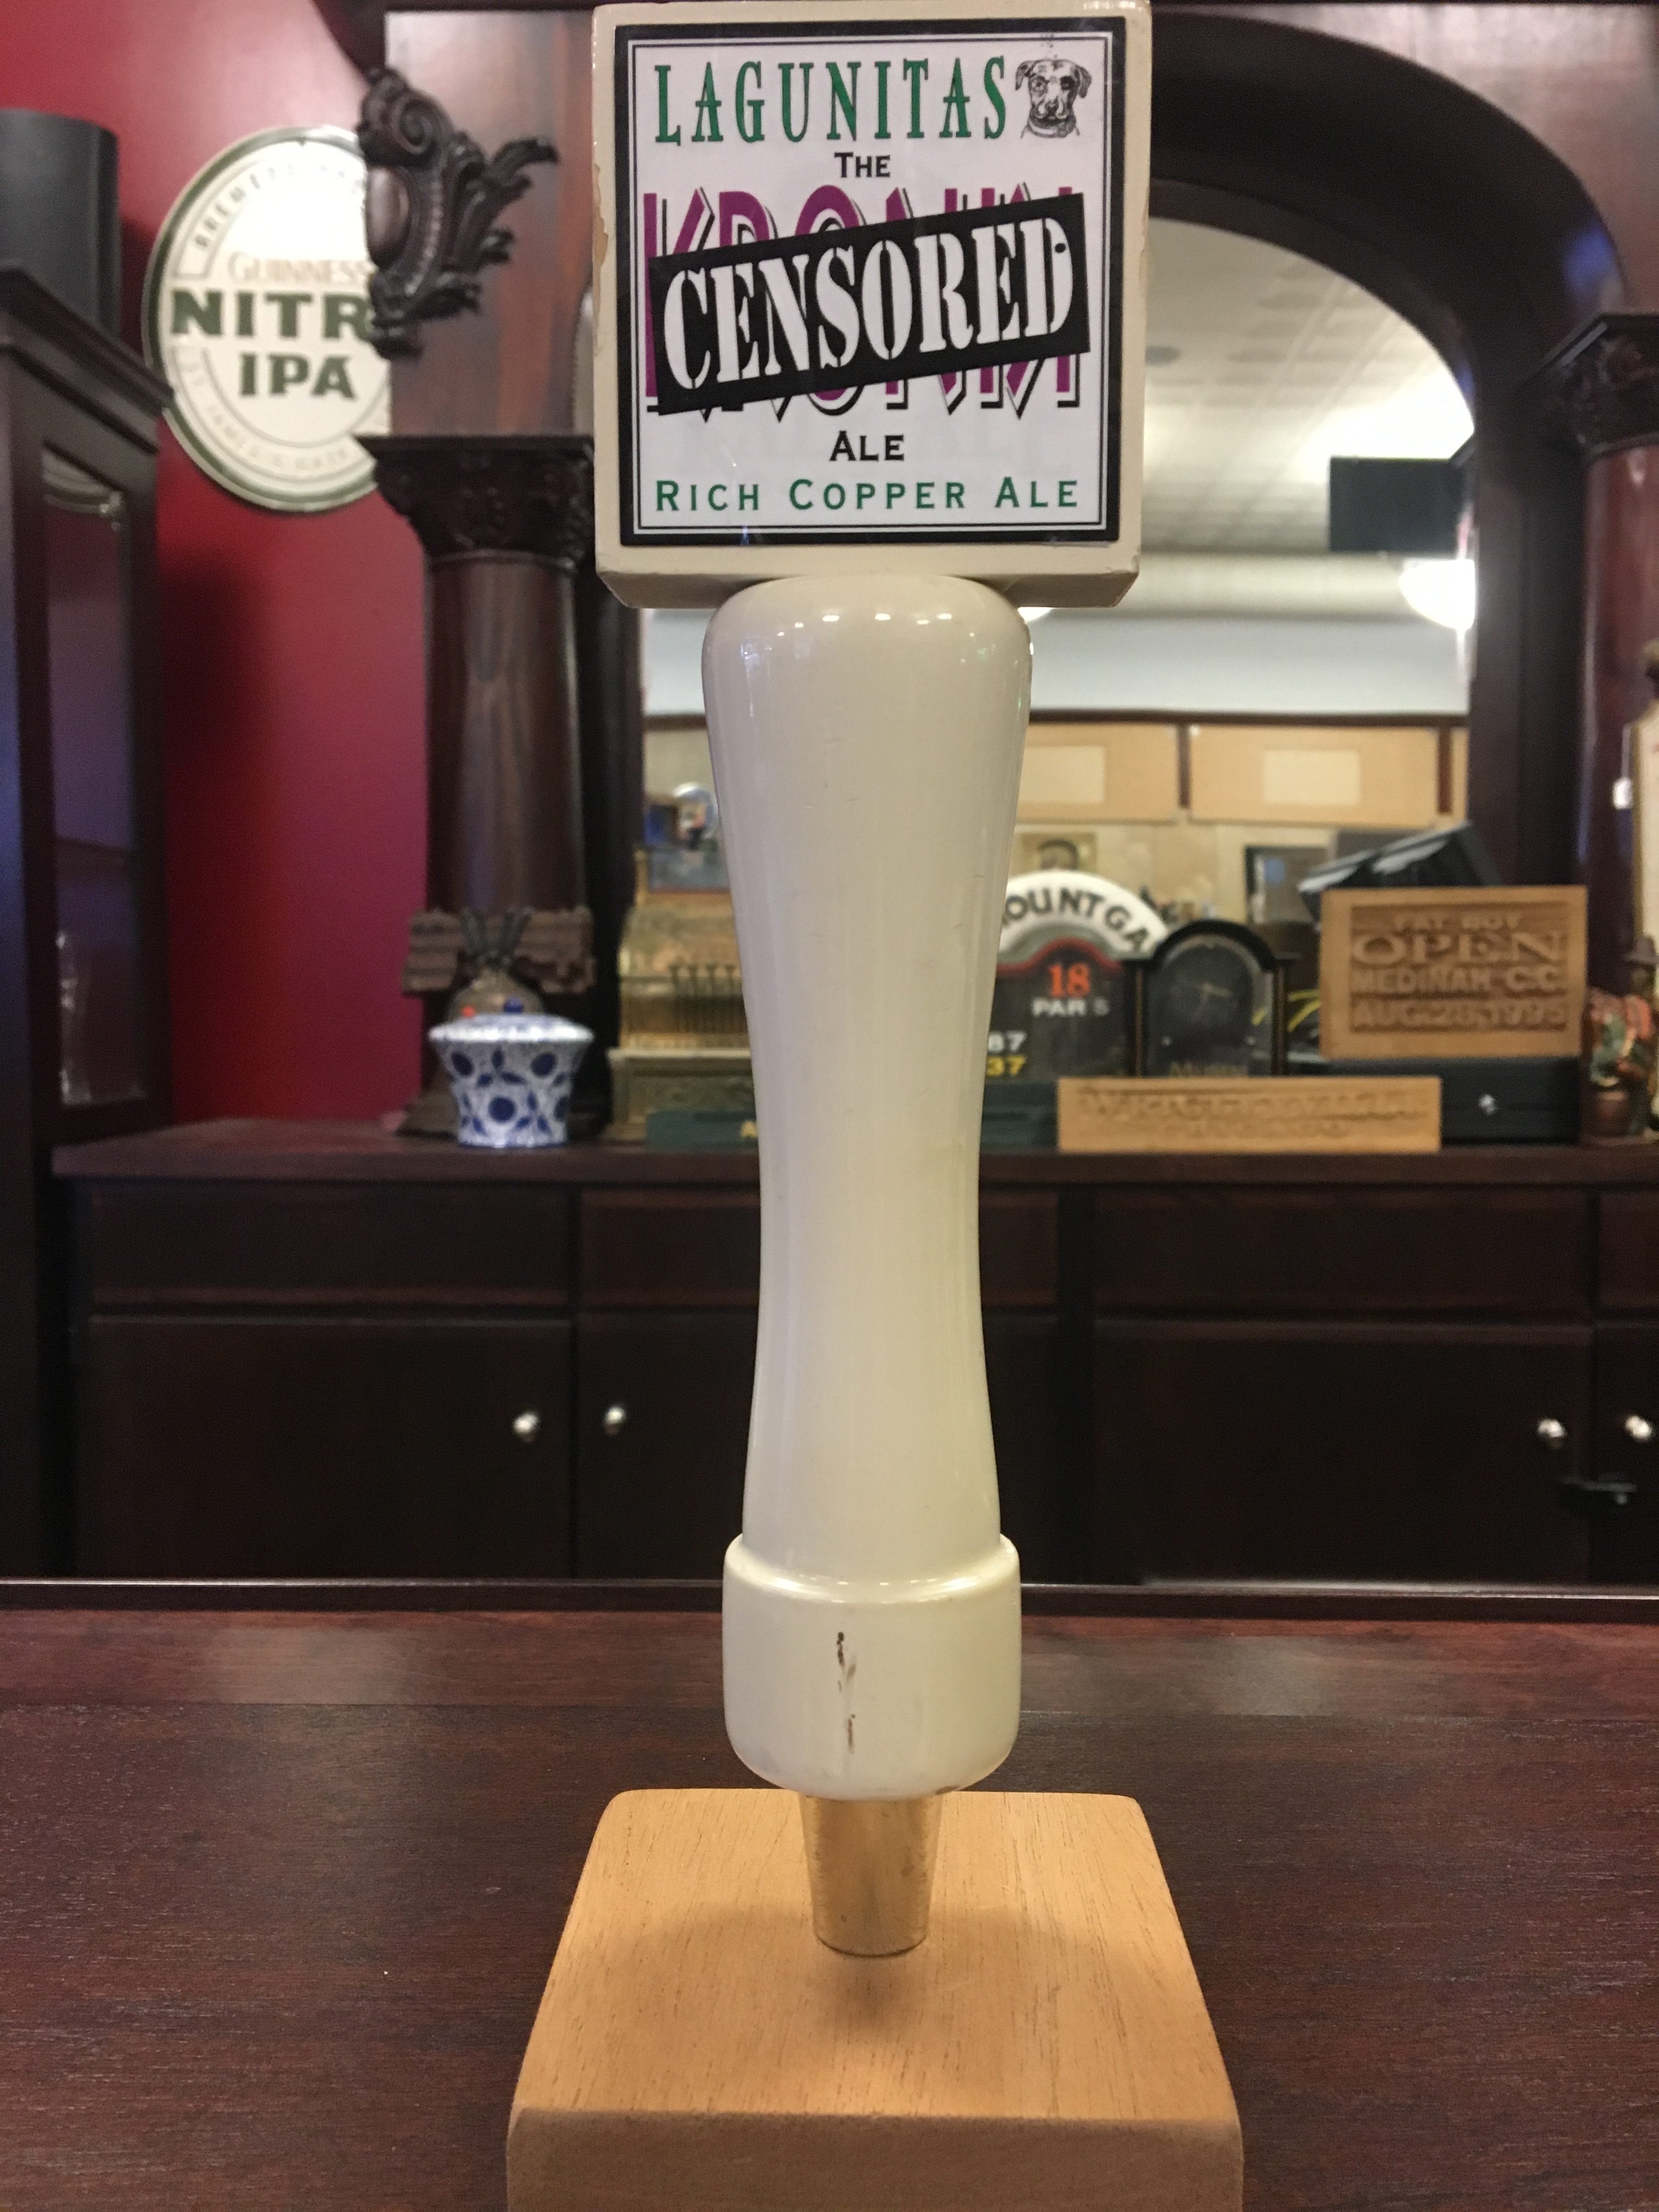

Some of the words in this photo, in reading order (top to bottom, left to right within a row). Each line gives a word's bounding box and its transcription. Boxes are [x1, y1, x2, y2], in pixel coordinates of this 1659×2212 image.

[654, 55, 1007, 146] LAGUNITAS
[169, 287, 374, 341] NITR
[663, 216, 1074, 391] CENSORED
[238, 352, 358, 400] IPA
[1351, 932, 1568, 965] OPEN
[1048, 963, 1091, 998] 18
[1031, 998, 1087, 1017] PAR
